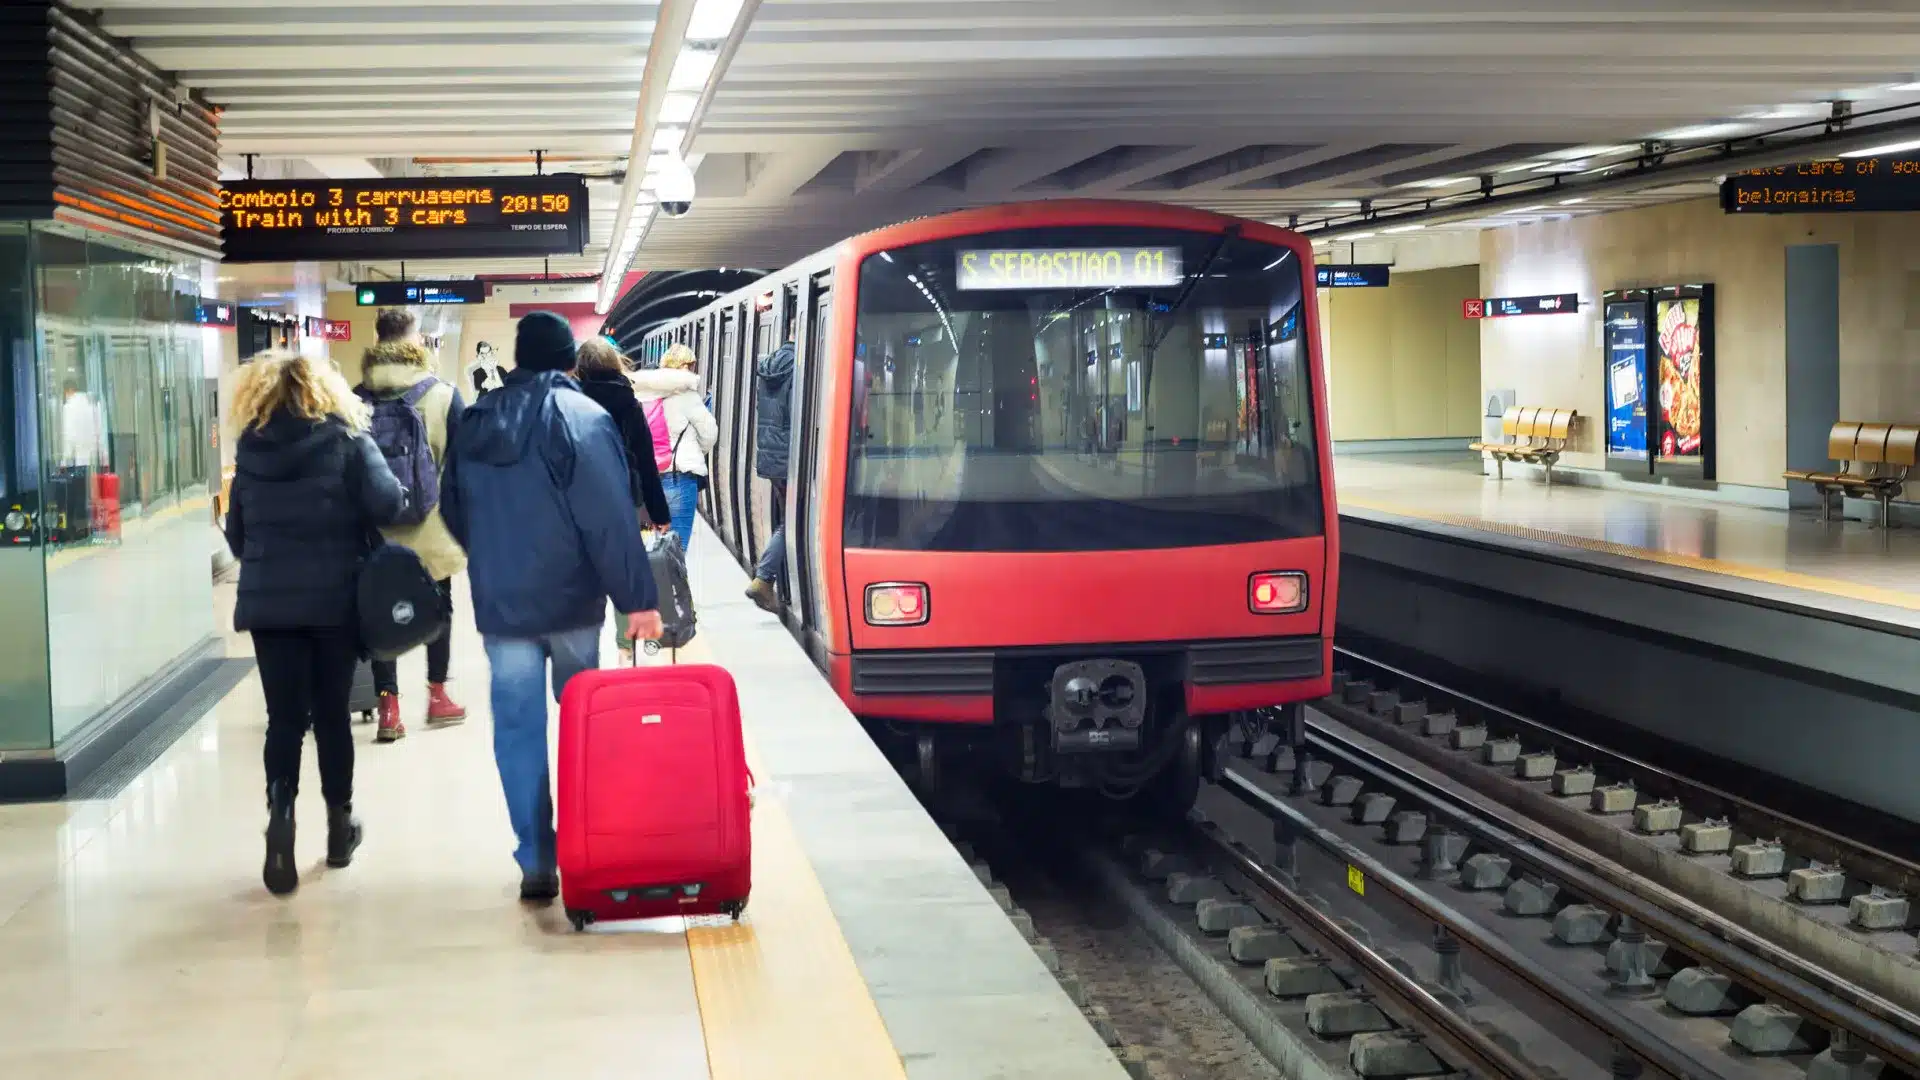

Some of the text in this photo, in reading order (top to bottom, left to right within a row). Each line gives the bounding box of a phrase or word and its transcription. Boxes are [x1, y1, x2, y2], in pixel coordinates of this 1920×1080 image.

[1856, 158, 1878, 174] of
[218, 188, 493, 208] Comboio 3 carruagens
[501, 195, 569, 213] 20:50
[1738, 187, 1856, 204] belongings
[233, 207, 467, 227] Train with 3 cars
[962, 253, 978, 280] S
[1134, 250, 1163, 280] 01
